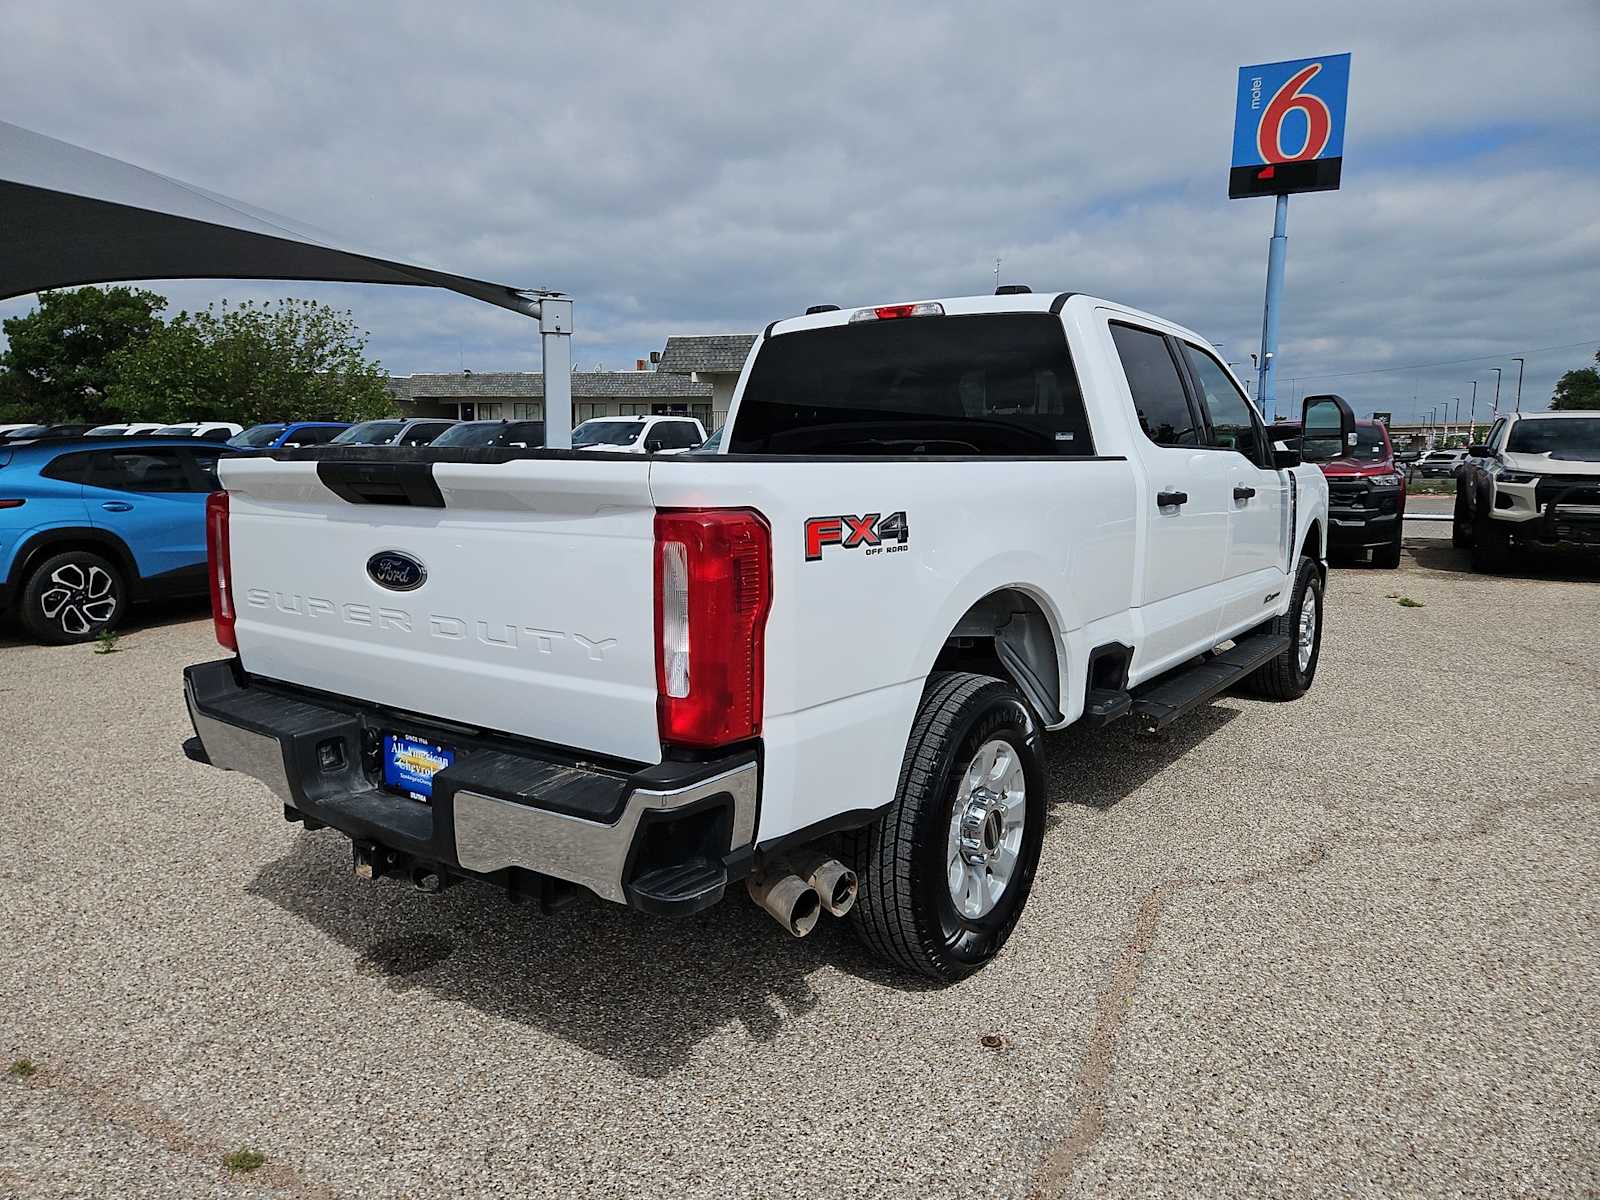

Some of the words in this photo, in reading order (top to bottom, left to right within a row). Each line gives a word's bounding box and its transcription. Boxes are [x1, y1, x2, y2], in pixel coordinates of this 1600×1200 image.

[1251, 77, 1262, 110] motel
[1256, 62, 1332, 165] 6
[804, 511, 909, 562] FX4
[865, 548, 883, 556] OFF
[886, 545, 909, 554] ROAD
[377, 559, 409, 583] Ford
[247, 588, 412, 633] SUPER
[430, 614, 617, 662] DUTY
[391, 742, 404, 753] All
[407, 746, 449, 767] American
[399, 759, 434, 777] Chevrol
